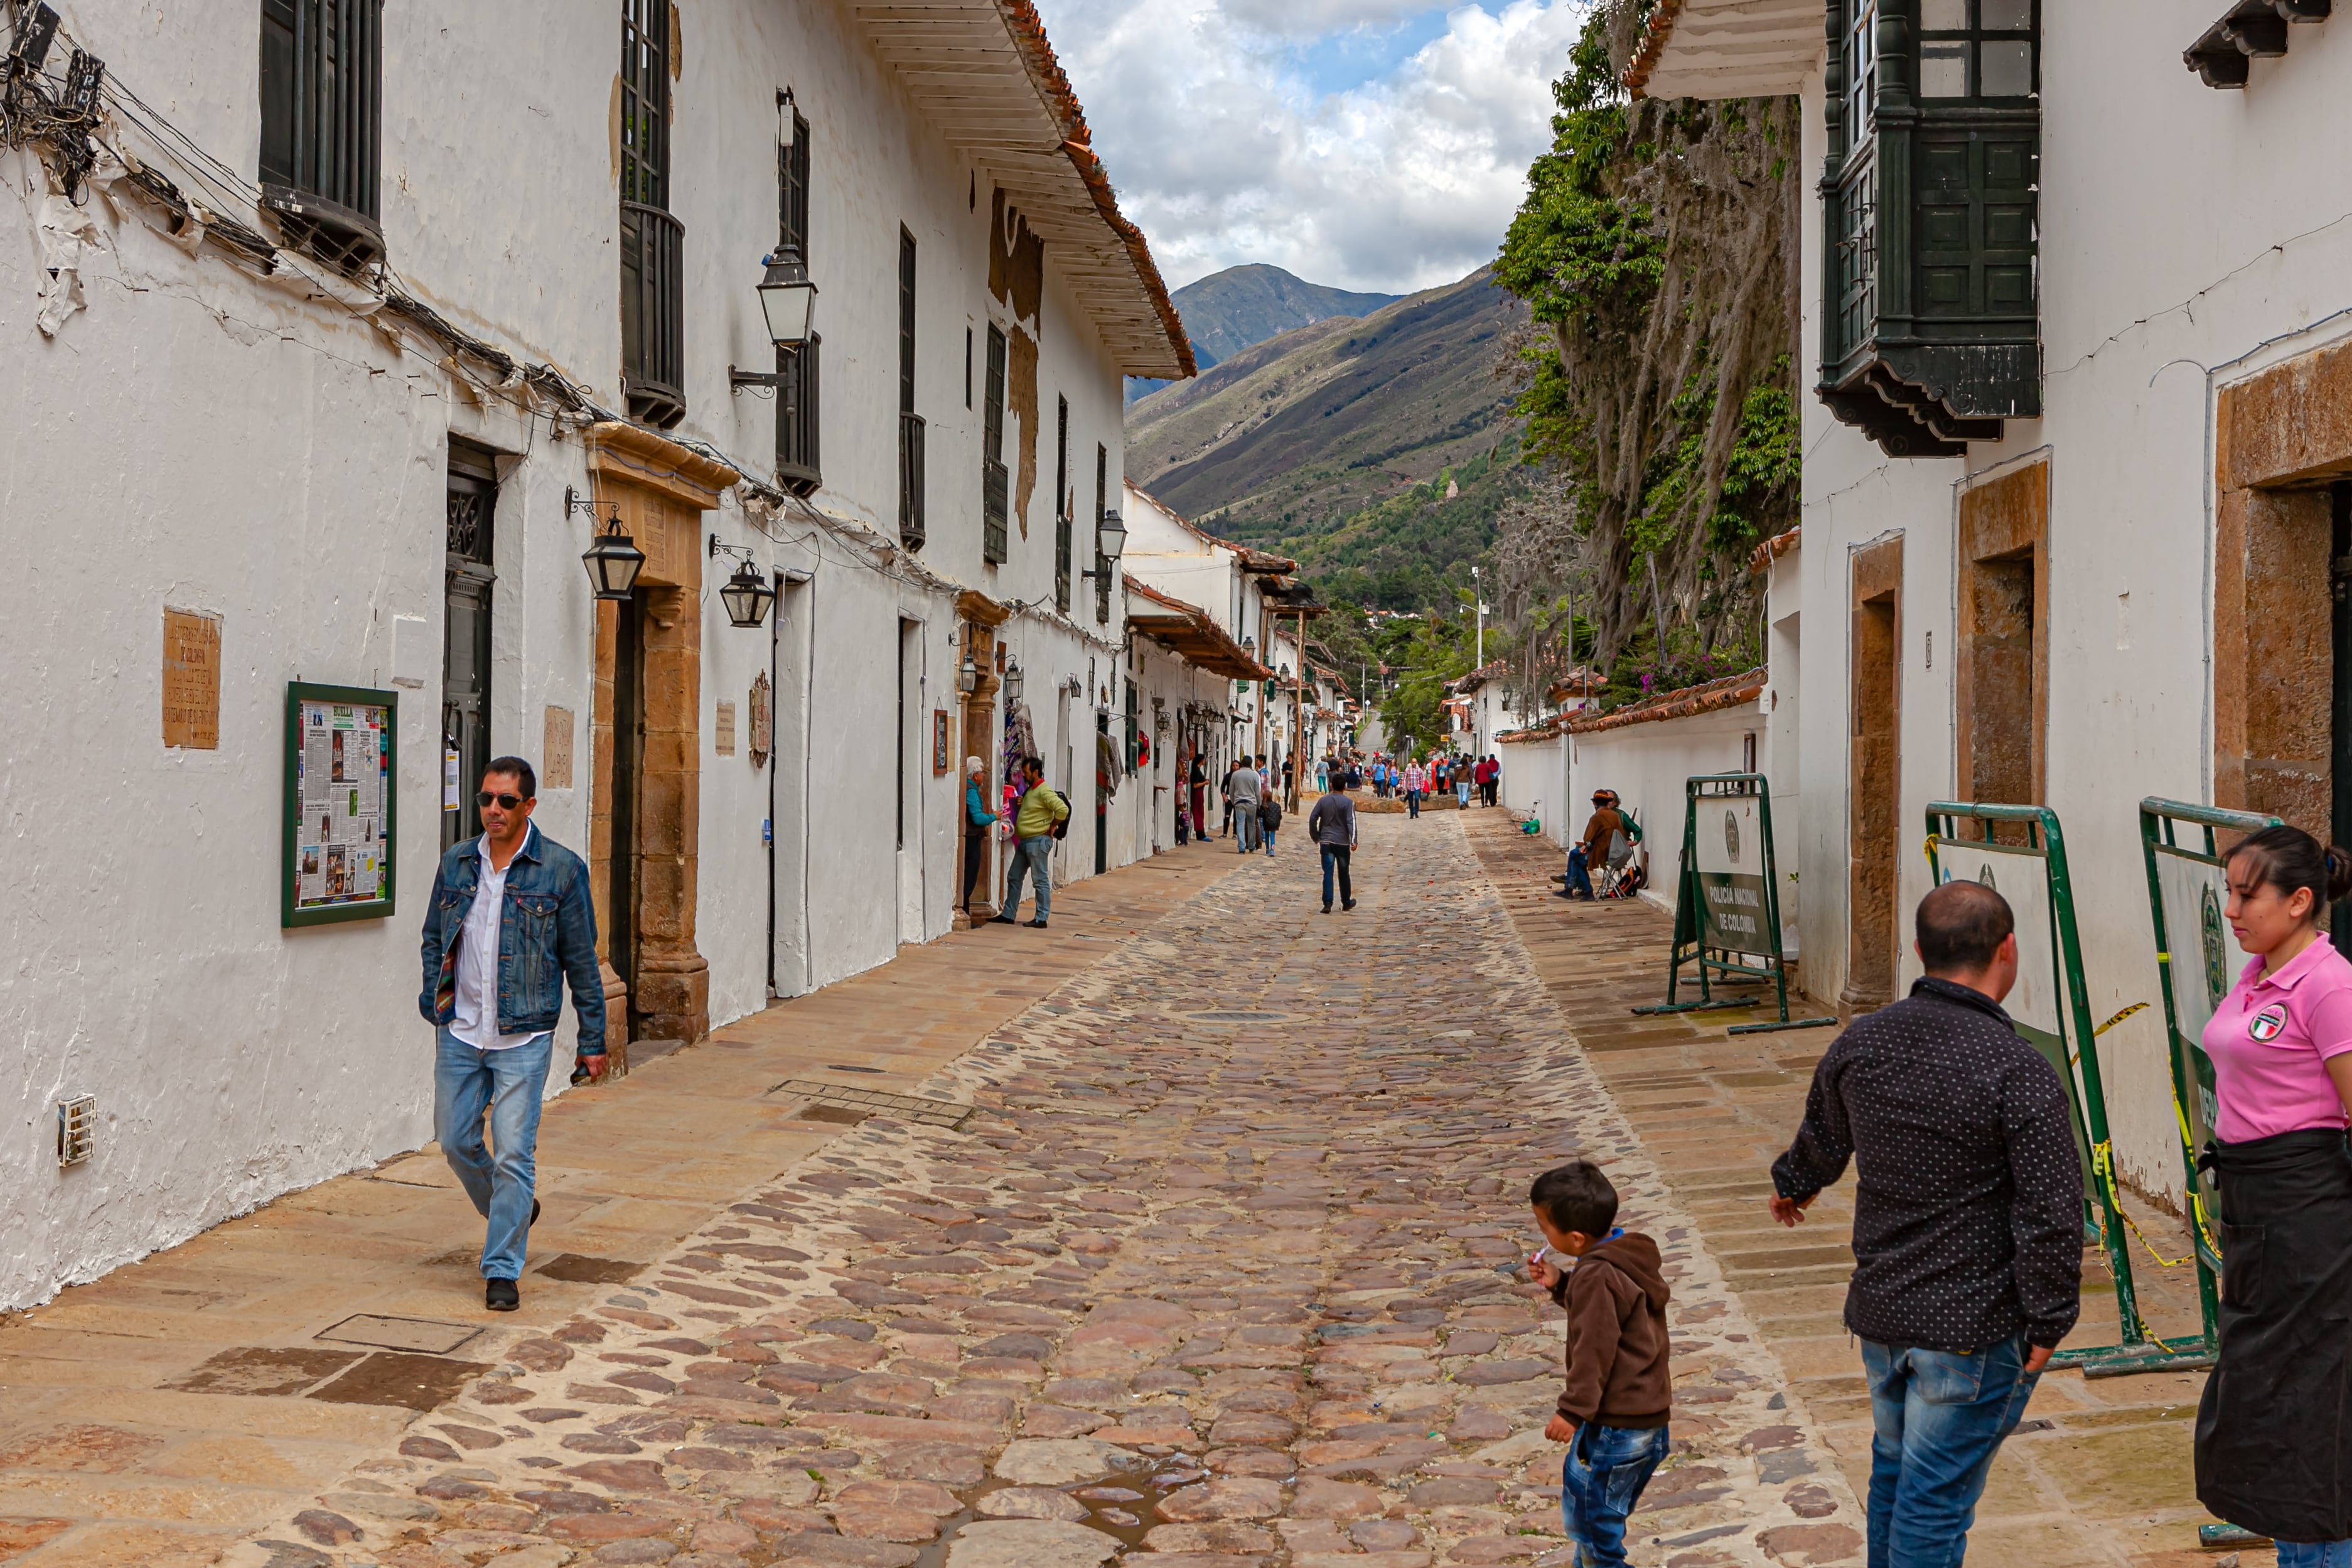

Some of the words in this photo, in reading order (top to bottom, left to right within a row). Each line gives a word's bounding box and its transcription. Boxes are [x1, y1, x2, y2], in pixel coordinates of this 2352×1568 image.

[333, 706, 353, 717] HUELLA
[1709, 883, 1734, 905] POLICÍA
[1734, 888, 1759, 908] NACIONAL
[1719, 913, 1728, 930] DE
[1727, 913, 1756, 934] COLOMBIA
